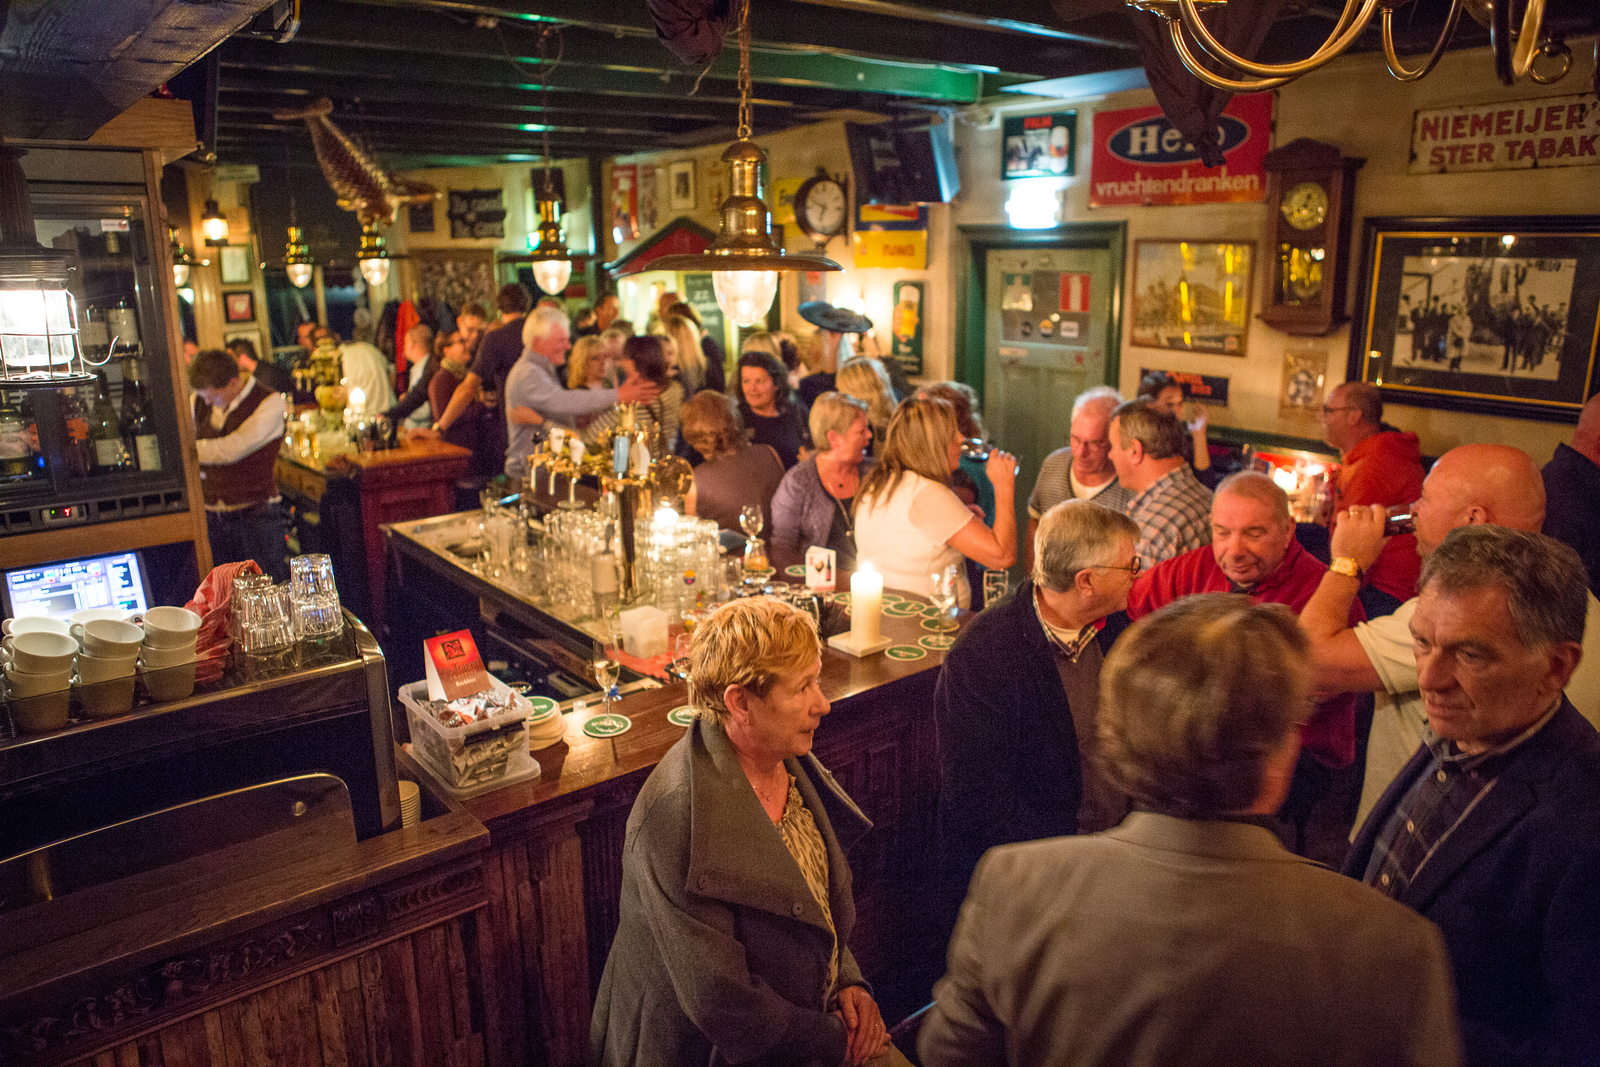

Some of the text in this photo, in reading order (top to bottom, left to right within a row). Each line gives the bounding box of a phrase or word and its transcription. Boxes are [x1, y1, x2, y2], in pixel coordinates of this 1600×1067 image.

[1421, 100, 1600, 141] NIEMEIJER'
[1430, 134, 1600, 166] STER TABAK
[1096, 165, 1260, 196] vruchtendranken
